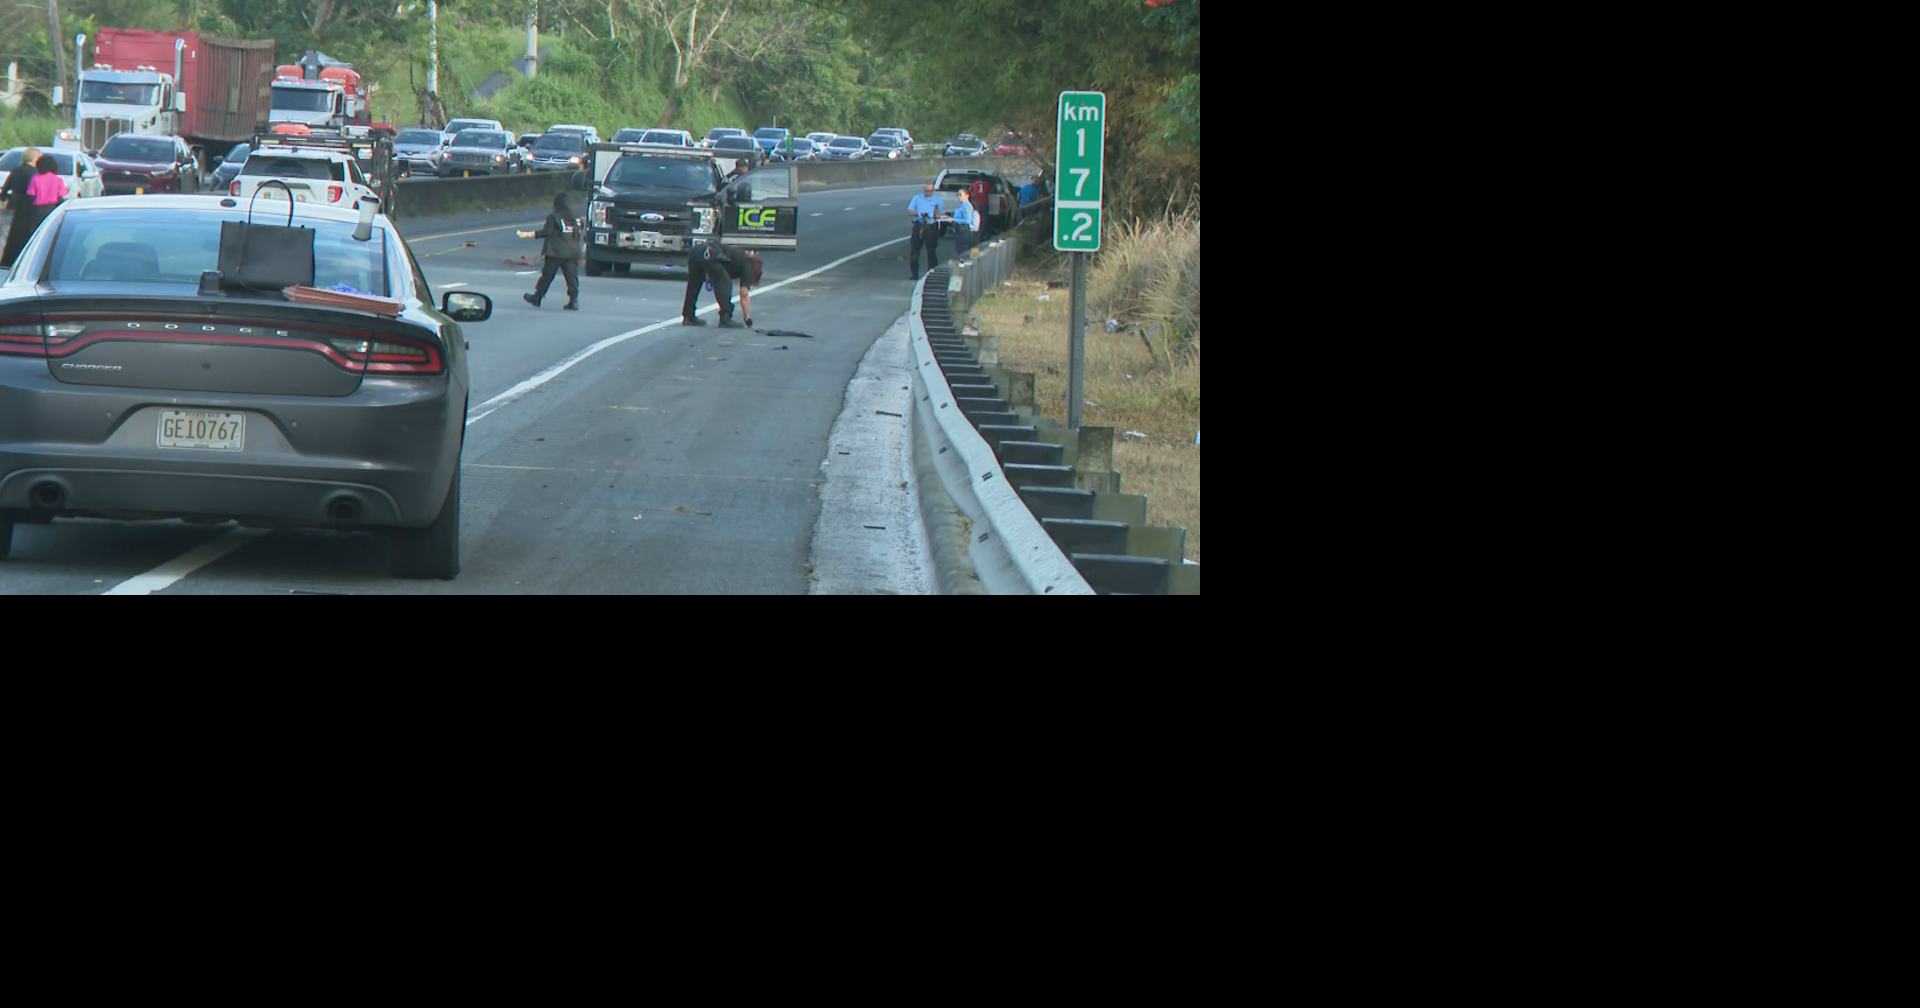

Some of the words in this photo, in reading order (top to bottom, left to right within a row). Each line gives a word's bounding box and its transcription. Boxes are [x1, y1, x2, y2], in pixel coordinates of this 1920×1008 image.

[1064, 101, 1099, 122] km
[1062, 212, 1093, 241] .2
[127, 322, 288, 337] DODGE
[164, 418, 239, 441] GE10767
